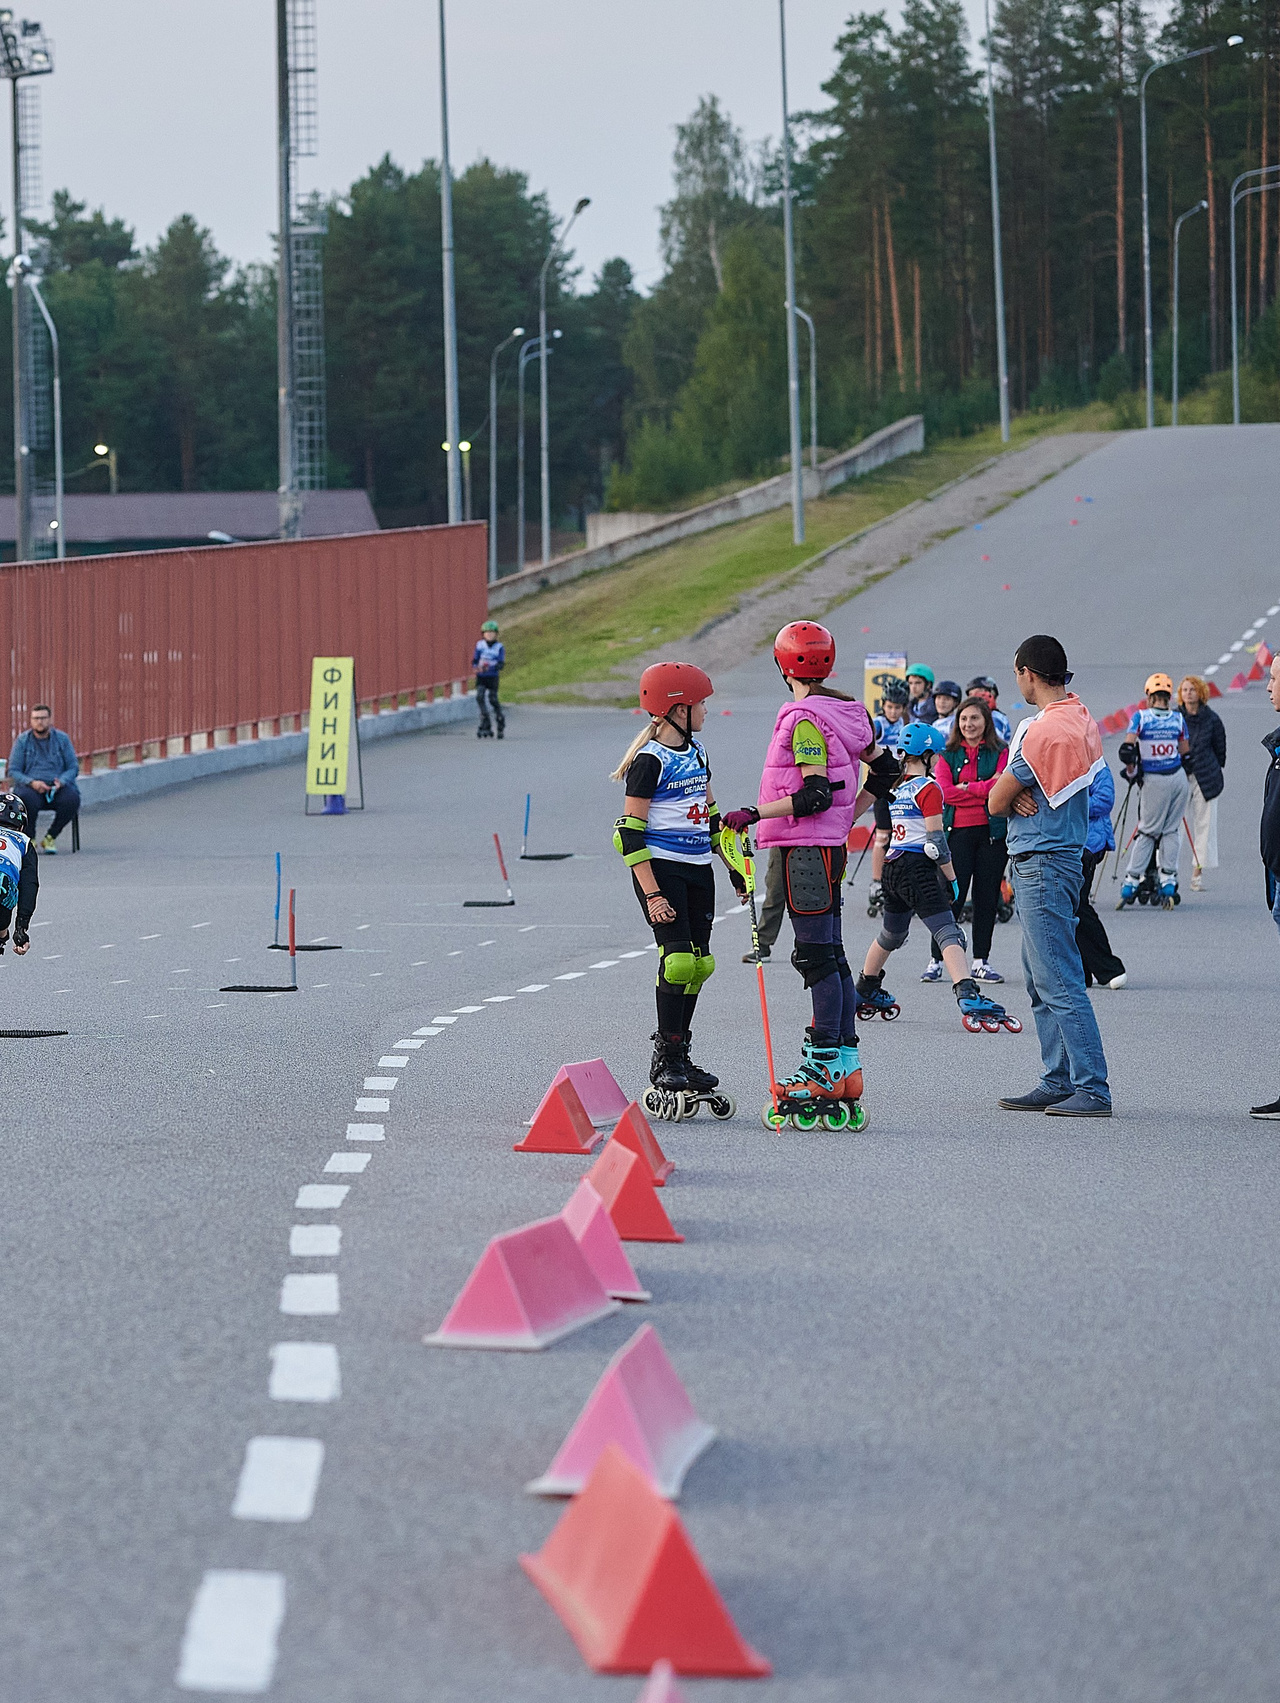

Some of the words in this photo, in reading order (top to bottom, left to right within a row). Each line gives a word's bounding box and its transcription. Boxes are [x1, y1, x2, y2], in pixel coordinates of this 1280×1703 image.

[315, 666, 342, 785] ФИНИШ
[1151, 744, 1174, 756] 100
[686, 803, 709, 825] 44
